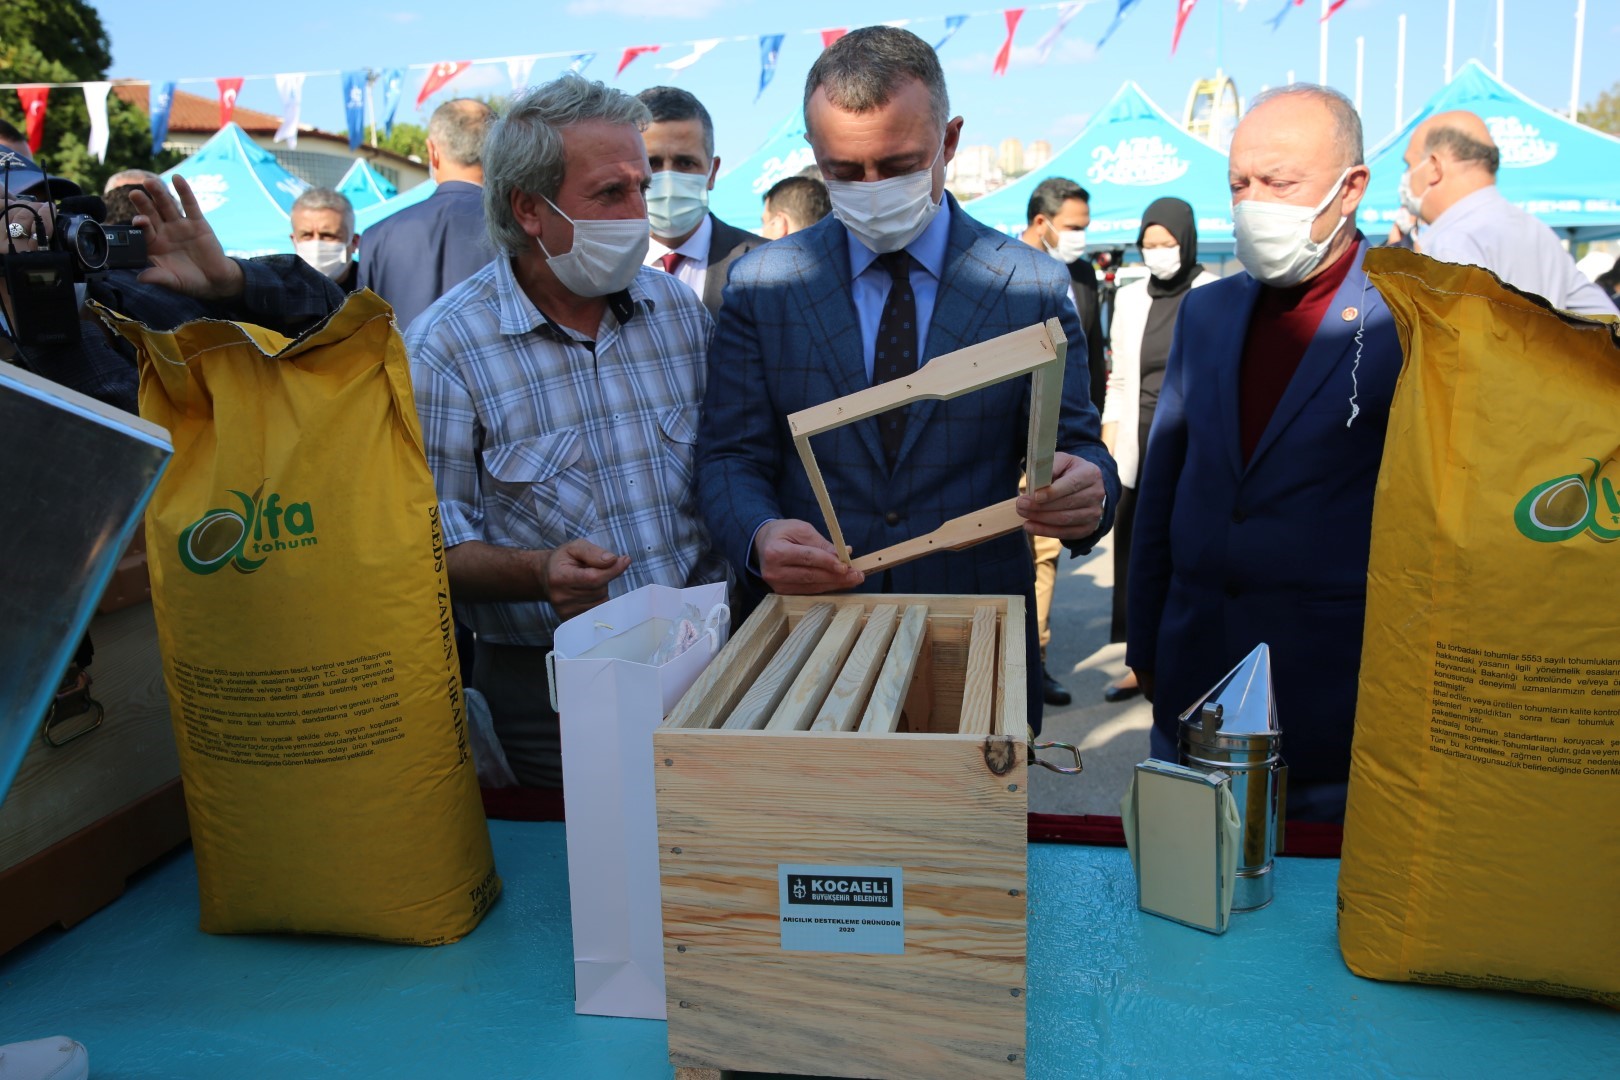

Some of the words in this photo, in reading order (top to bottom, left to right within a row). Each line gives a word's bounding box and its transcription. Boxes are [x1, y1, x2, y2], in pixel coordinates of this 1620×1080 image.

[252, 536, 318, 554] tohum
[428, 504, 445, 573] SEEDS
[437, 587, 453, 662] ZADEN
[311, 662, 335, 672] kontrol
[346, 650, 392, 666] sertifikasyonu
[1435, 651, 1475, 664] hakkındaki
[1478, 659, 1510, 670] yasanın
[1515, 664, 1531, 672] ilgili
[1536, 665, 1581, 675] yönetmelik
[1436, 641, 1446, 649] Bu
[1448, 643, 1482, 656] torbadaki
[1484, 650, 1519, 661] tohumlar
[1521, 654, 1542, 663] 5553
[1544, 656, 1566, 666] sayılı
[298, 674, 320, 683] uygun
[322, 678, 347, 687] kurallar
[361, 680, 378, 688] veya
[1434, 669, 1474, 684] konusunda
[1478, 678, 1517, 690] deneyimli
[1522, 685, 1585, 695] uzmanlarımızın
[1435, 660, 1477, 675] Hayvancılık
[1481, 669, 1518, 681] Bakanlığı
[1523, 674, 1572, 684] kontrolünde
[1577, 678, 1609, 687] ve/veya
[348, 699, 371, 709] gerekli
[372, 693, 399, 704] ilaçlama
[353, 707, 375, 716] uygun
[379, 700, 400, 710] olarak
[1432, 698, 1462, 710] işlemleri
[1469, 706, 1512, 719] yapıldıktan
[1519, 714, 1543, 722] sonra
[1550, 716, 1570, 724] ticari
[1578, 718, 1615, 726] tohumluk
[1449, 693, 1471, 703] edilen
[1473, 698, 1492, 706] veya
[1493, 699, 1523, 710] üretilen
[1524, 703, 1568, 714] tohumların
[1569, 707, 1591, 716] kalite
[344, 725, 366, 735] uygun
[369, 715, 403, 730] koşullarda
[1431, 716, 1461, 730] Ambalaj
[1464, 724, 1499, 736] tohumun
[1503, 731, 1557, 743] standartlarını
[1563, 737, 1605, 747] koruyacak
[327, 746, 347, 755] dolayı
[371, 732, 405, 746] kalitesinde
[336, 736, 357, 745] olarak
[1430, 726, 1471, 740] saklanması
[1502, 739, 1540, 751] Tohumlar
[1572, 748, 1591, 756] gıda
[1602, 749, 1620, 757] yem
[1430, 735, 1446, 745] Tüm
[1450, 740, 1460, 748] bu
[1464, 743, 1505, 757] kontrollere
[1510, 751, 1542, 762] rağmen
[1547, 756, 1582, 765] olumsuz
[304, 754, 347, 765] Mahkemeleri
[1429, 744, 1472, 760] standartlara
[1472, 755, 1522, 769] uygunsuzluk
[1522, 762, 1582, 775] belirlendiğinde
[1583, 767, 1610, 775] Gönen
[783, 916, 813, 924] ARICILIK
[861, 918, 901, 926] ÜRÜNÜDÜR
